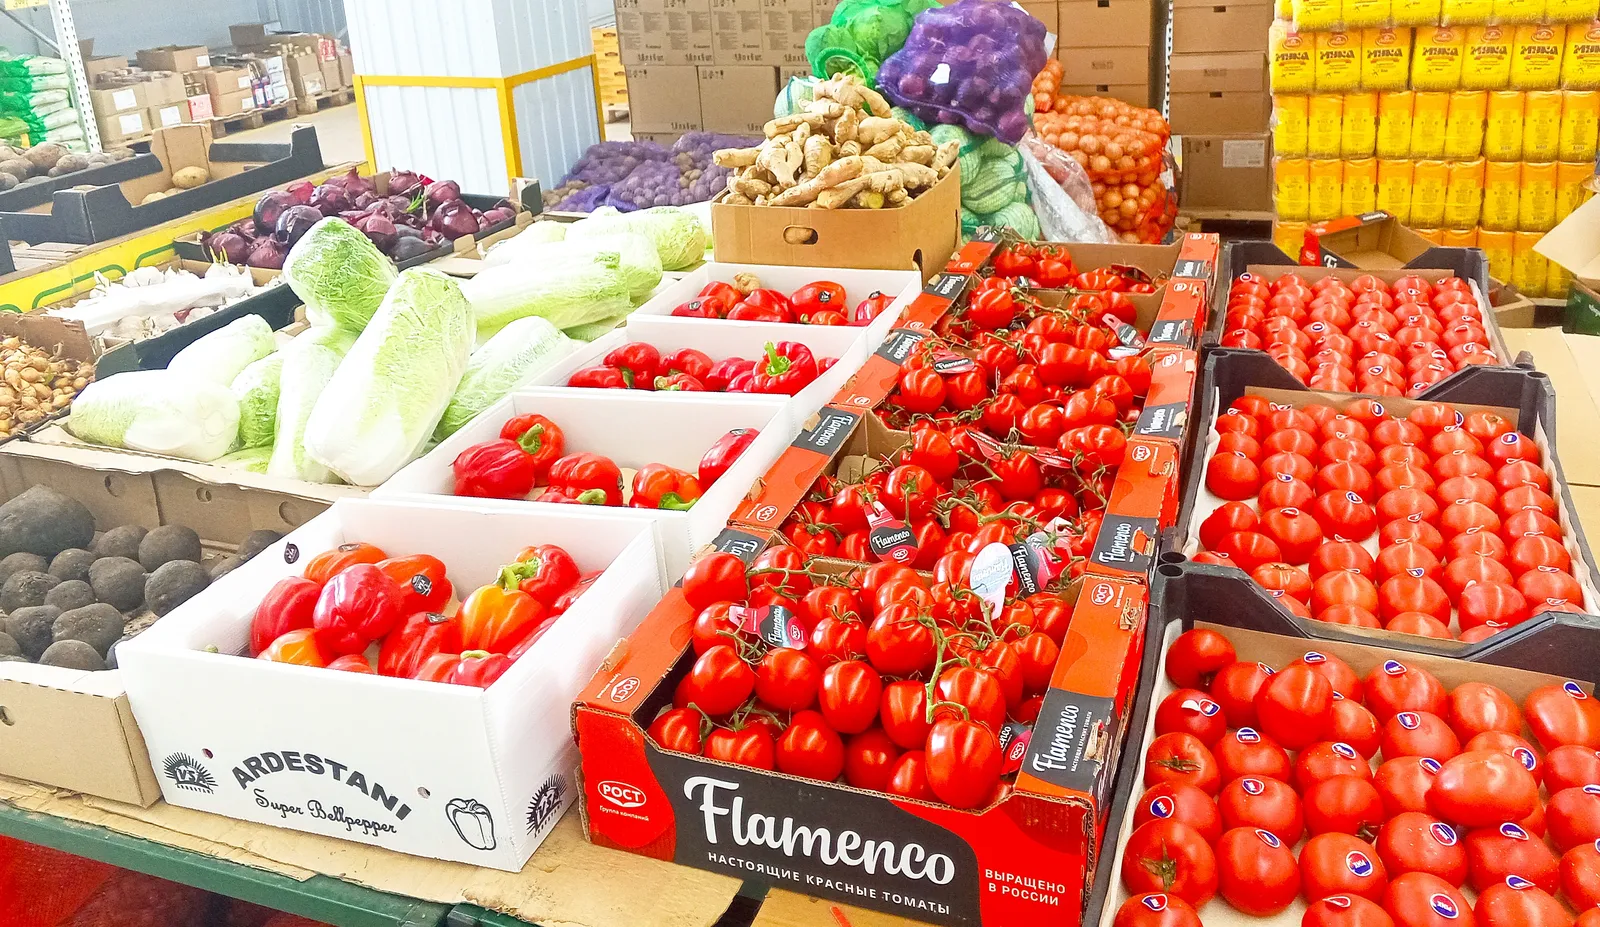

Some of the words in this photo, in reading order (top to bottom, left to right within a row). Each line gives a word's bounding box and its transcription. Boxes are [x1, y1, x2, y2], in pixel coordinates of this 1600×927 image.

[871, 530, 911, 551] Flamenco
[1012, 545, 1036, 593] Flamenco
[1032, 704, 1080, 772] Flamenco
[232, 750, 412, 821] ARDESTANI
[602, 783, 642, 802] РОСТ
[253, 788, 304, 819] Super
[307, 799, 397, 837] Bellpepper
[599, 805, 620, 816] Группа
[619, 810, 650, 822] компаний
[683, 775, 956, 886] Flamenco
[707, 851, 800, 882] НАСТОЯЩИЕ
[805, 874, 877, 899] КРАСНЫЕ
[882, 890, 950, 916] ТОМАТЫ
[984, 868, 1066, 894] ВЫРАЩЕНО
[988, 882, 997, 893] В
[1001, 885, 1059, 907] РОССИИ
